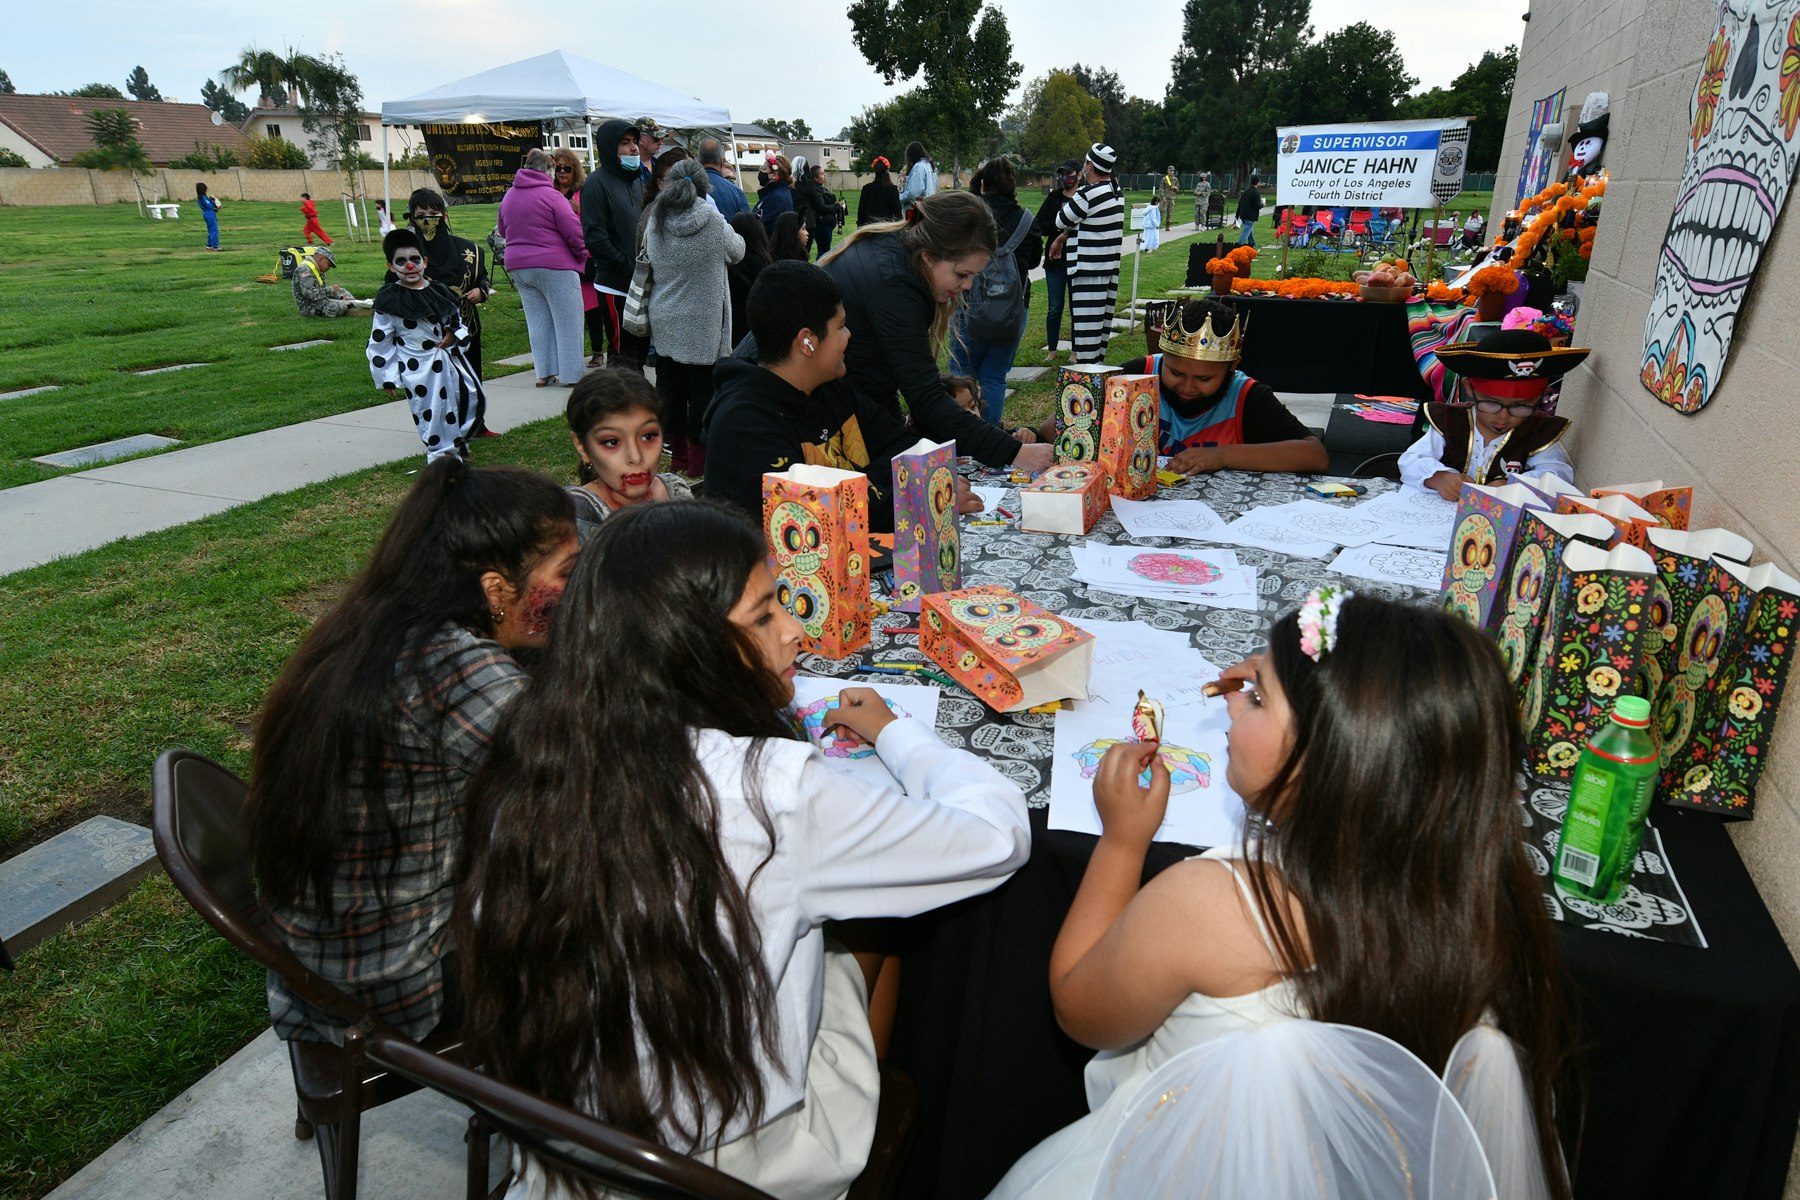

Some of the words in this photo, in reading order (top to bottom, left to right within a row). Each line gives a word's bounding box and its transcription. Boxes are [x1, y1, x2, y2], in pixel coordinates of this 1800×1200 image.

[425, 123, 458, 135] UNITED
[1313, 135, 1408, 149] SUPERVISOR
[500, 145, 521, 153] PROGRAM
[1295, 158, 1357, 175] JANICE
[1363, 157, 1418, 174] HAHN
[1290, 178, 1325, 190] County
[1328, 178, 1341, 188] of
[1344, 178, 1363, 188] Los
[1367, 178, 1411, 190] Angeles
[1308, 190, 1340, 200] Fourth
[1344, 190, 1384, 201] District
[1583, 773, 1607, 788] aloe
